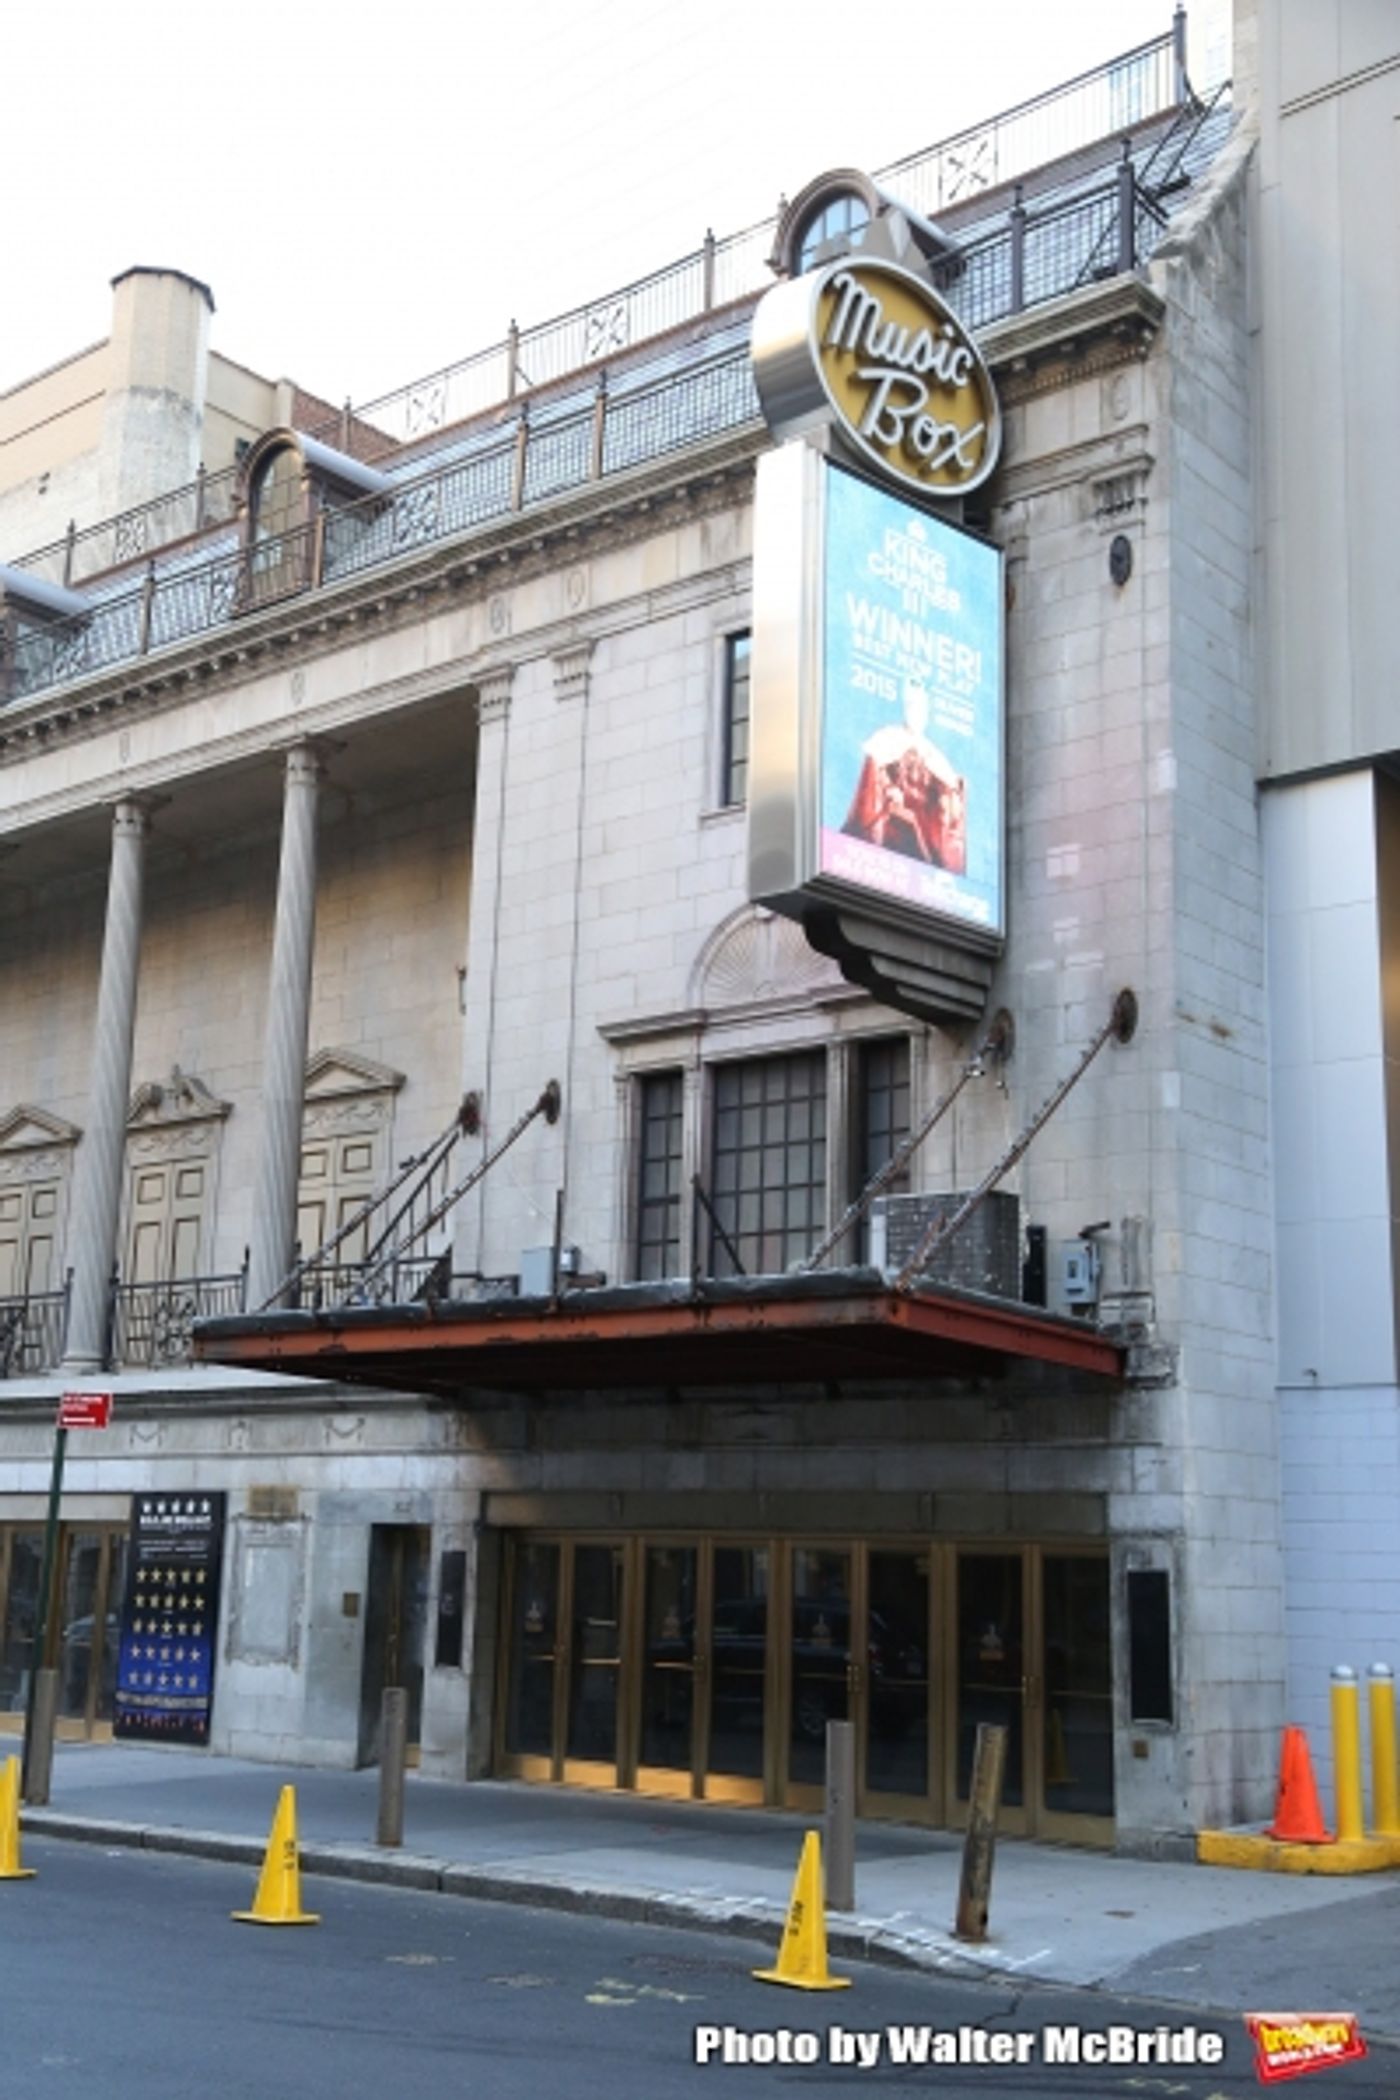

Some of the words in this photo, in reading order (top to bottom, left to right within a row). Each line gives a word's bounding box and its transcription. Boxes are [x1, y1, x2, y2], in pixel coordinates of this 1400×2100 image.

[830, 272, 974, 387] Music
[858, 367, 985, 470] Box
[885, 528, 946, 585] KING
[847, 591, 982, 684] WINNER!
[851, 664, 897, 701] 2015
